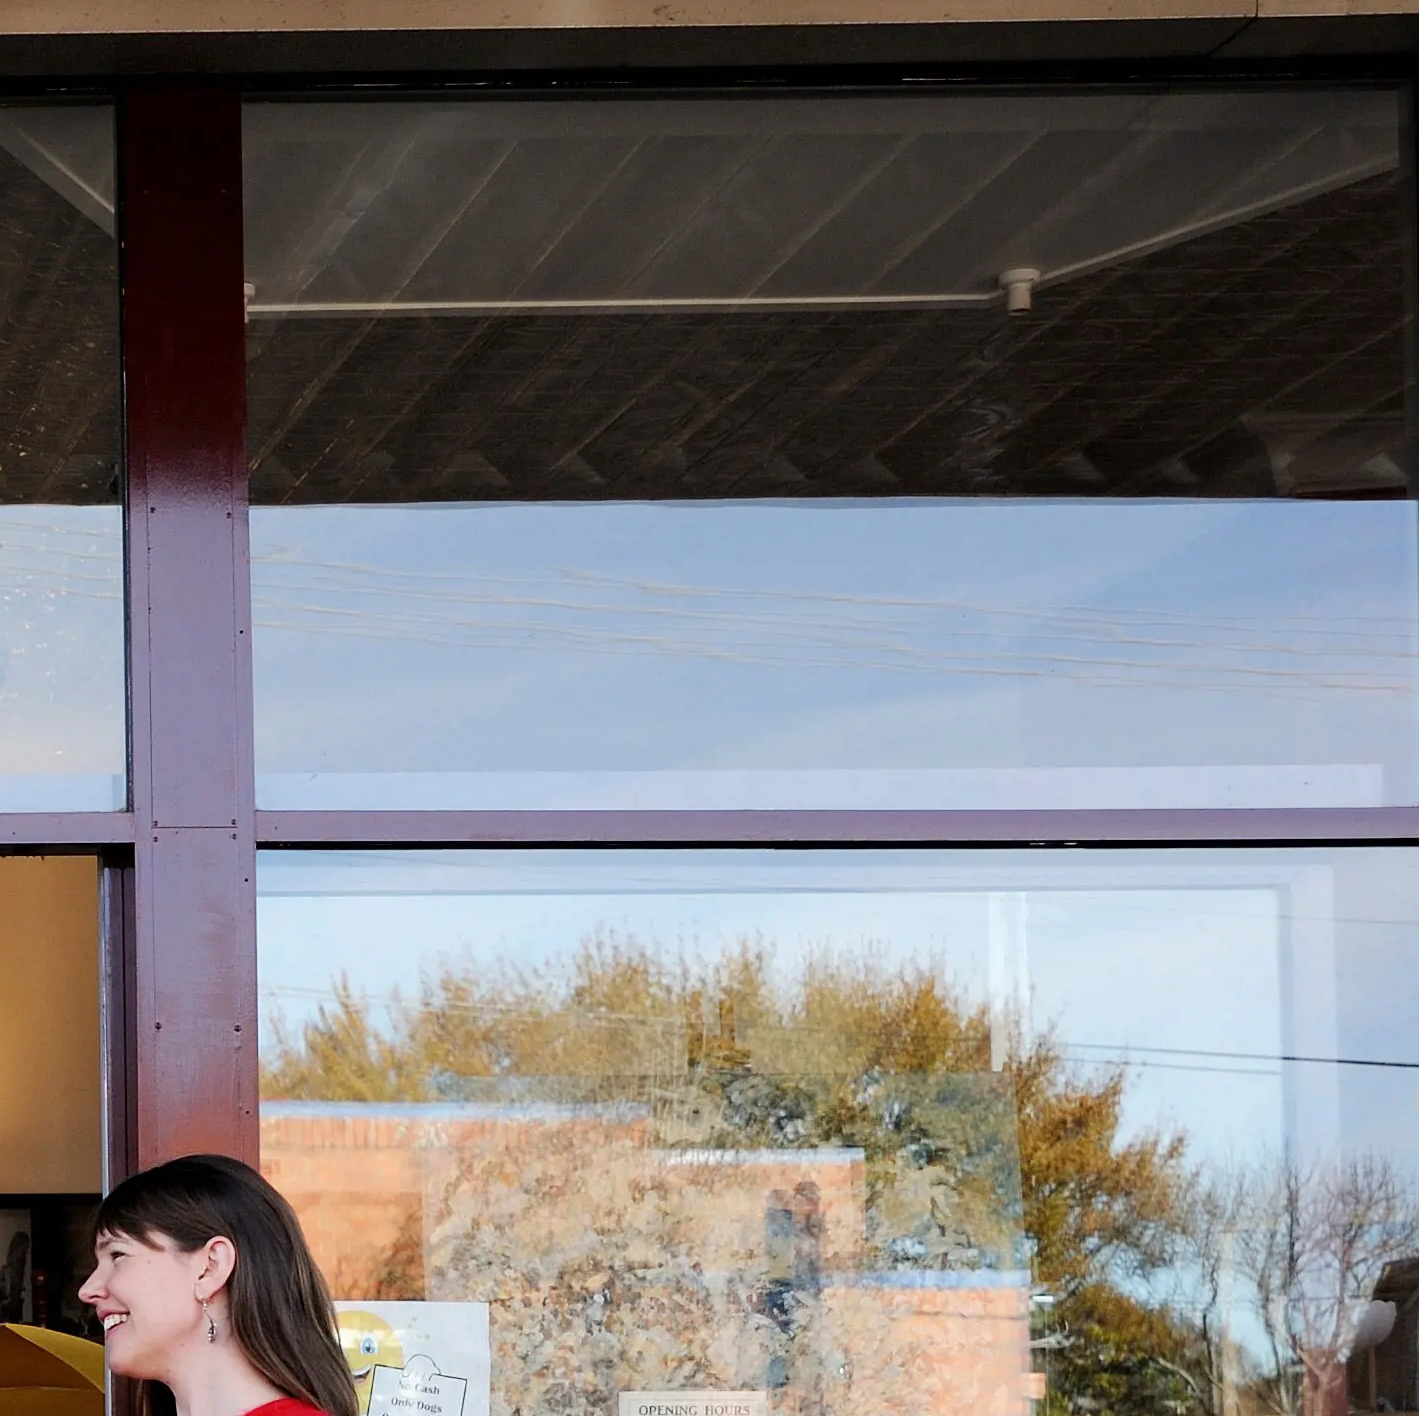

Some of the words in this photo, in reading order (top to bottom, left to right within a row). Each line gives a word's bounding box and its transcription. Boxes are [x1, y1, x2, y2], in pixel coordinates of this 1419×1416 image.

[415, 1383, 440, 1395] Cash
[391, 1396, 414, 1408] Only
[417, 1401, 442, 1414] Dogs
[638, 1405, 698, 1416] OPENING
[705, 1405, 751, 1416] HOURS
